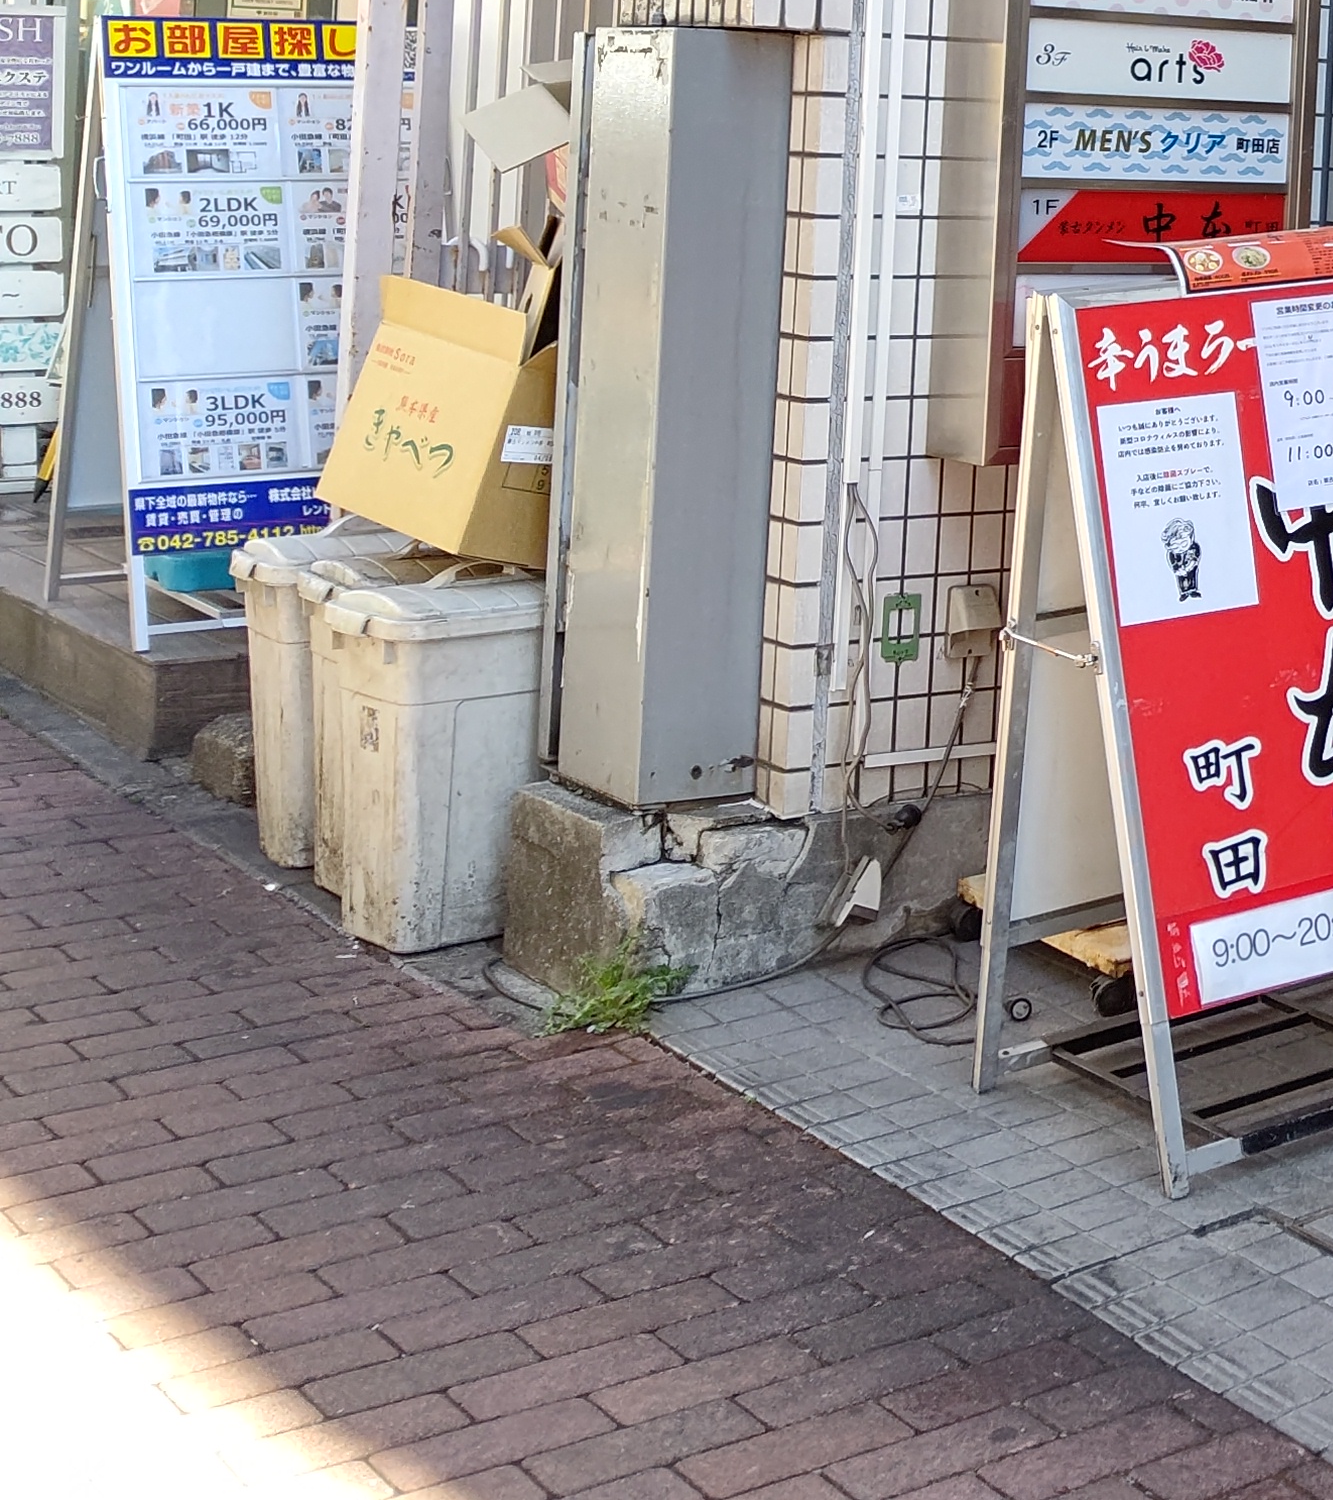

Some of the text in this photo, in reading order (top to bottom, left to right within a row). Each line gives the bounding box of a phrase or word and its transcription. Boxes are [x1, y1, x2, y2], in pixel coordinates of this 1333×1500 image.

[113, 23, 357, 57] お部屋探し
[1036, 44, 1071, 66] 3F
[1130, 53, 1206, 85] arts
[203, 102, 235, 119] 1K
[187, 119, 267, 132] 66,000円
[1038, 129, 1281, 155] 2F MEN'S クリア 町田店
[200, 197, 258, 213] 2LDK
[1032, 199, 1060, 215] 1F
[198, 213, 278, 229] 69,000円
[206, 394, 266, 411] 3LDK
[1284, 388, 1325, 408] 9:00
[204, 410, 286, 428] 95,000円
[1288, 443, 1333, 462] 11:00
[1184, 736, 1267, 897] 町田
